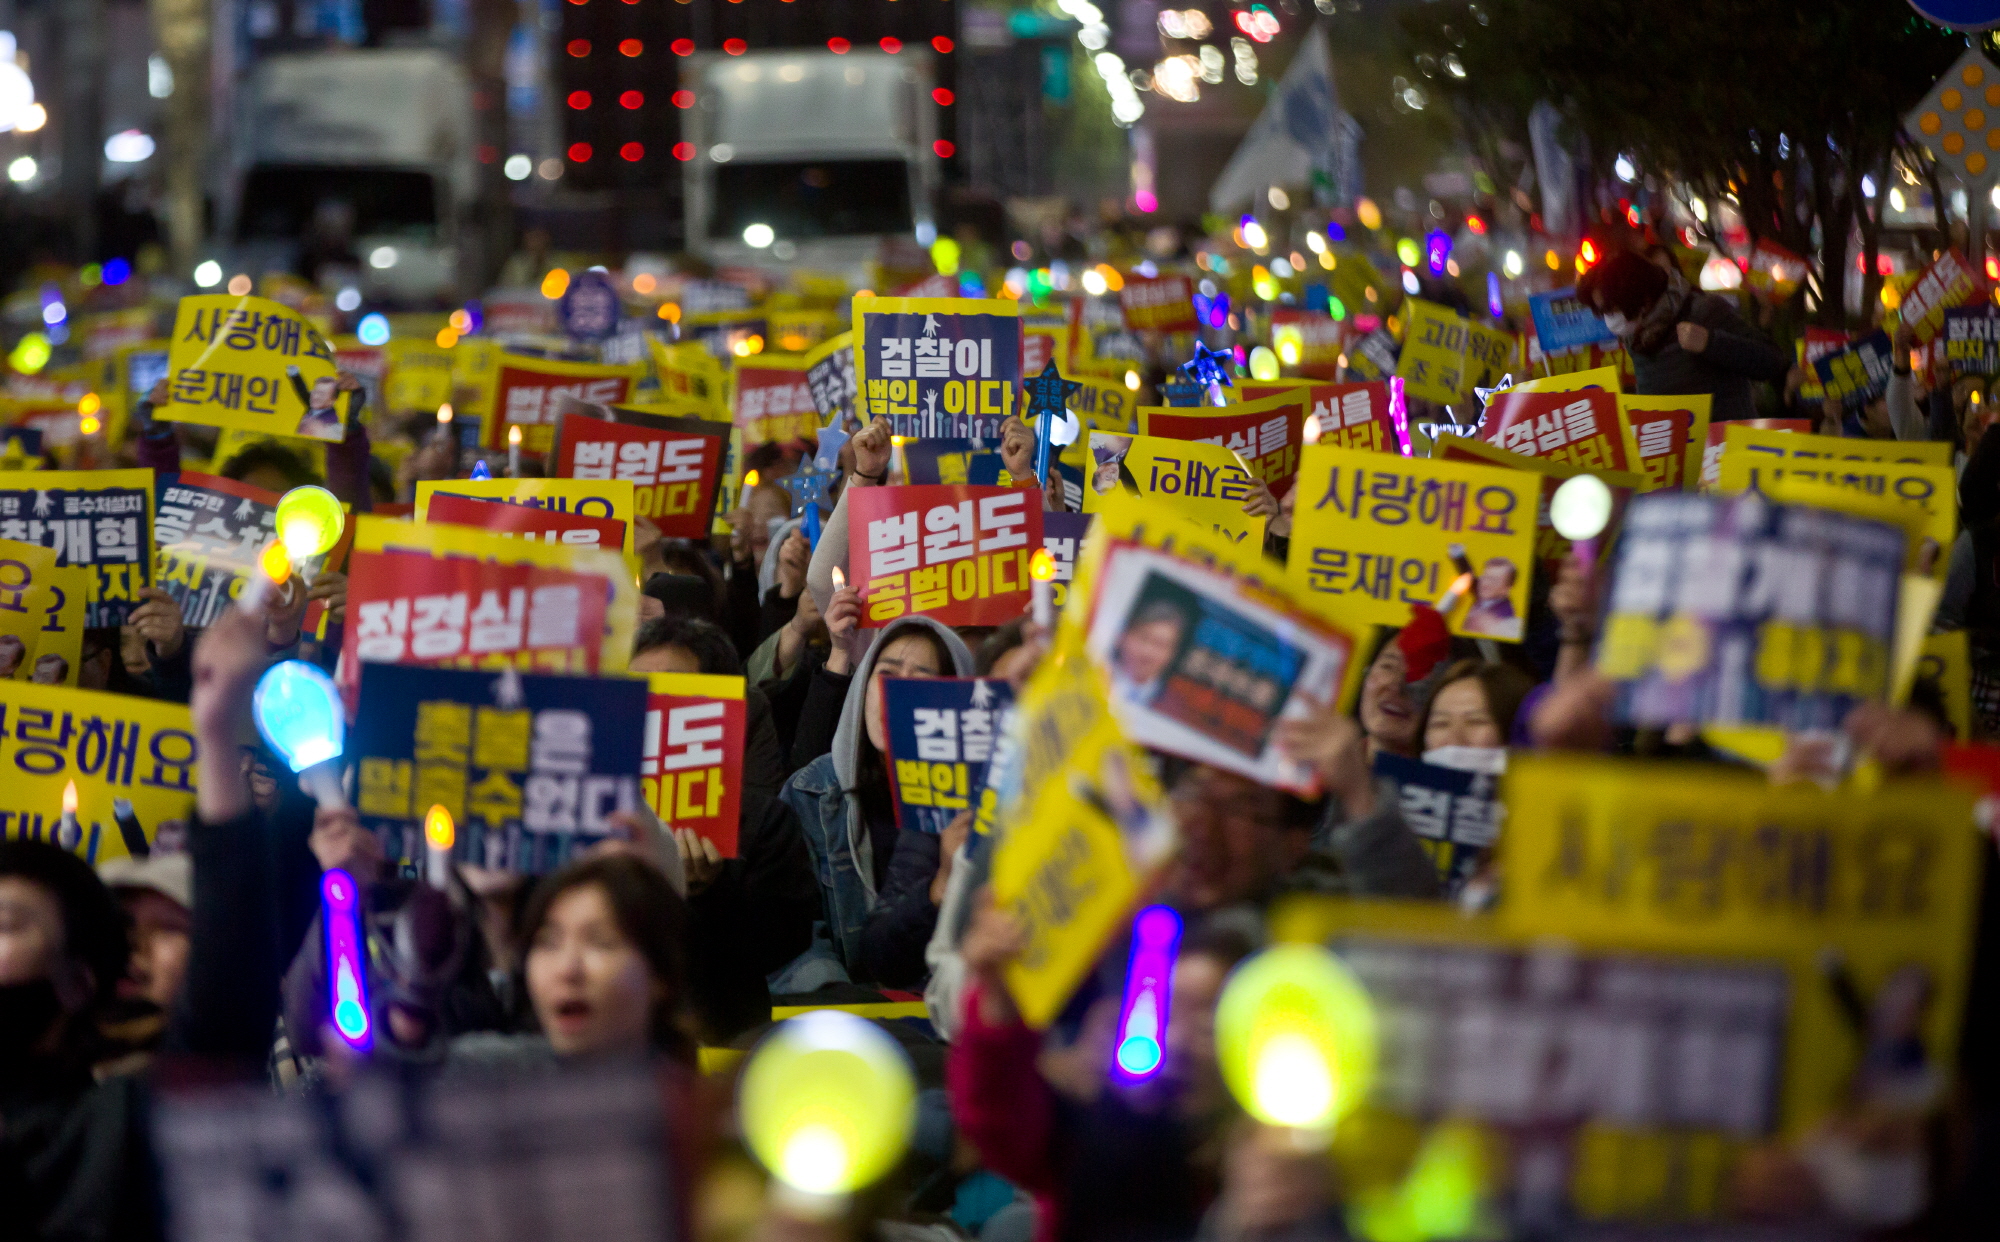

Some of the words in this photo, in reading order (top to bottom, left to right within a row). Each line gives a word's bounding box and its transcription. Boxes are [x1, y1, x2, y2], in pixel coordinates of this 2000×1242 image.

[183, 307, 333, 360] 사랑해요
[881, 336, 992, 378] 검찰이
[1416, 316, 1508, 371] 고마워요
[173, 369, 280, 414] 문재인
[867, 379, 918, 415] 범인
[943, 380, 1015, 416] 이다
[1068, 384, 1124, 420] 해요
[1312, 388, 1372, 433] 심을
[573, 438, 706, 486] 법원도
[1192, 414, 1288, 460] 심을
[162, 487, 226, 513] 검찰규탄
[634, 482, 700, 518] 이다
[1150, 456, 1250, 502] 문재인
[1314, 466, 1517, 535] 사랑해요
[0, 516, 139, 563] 찰개혁
[867, 492, 1028, 577] 법원도
[867, 548, 1031, 621] 공범이다
[1308, 547, 1439, 606] 문재인
[356, 584, 582, 662] 정경심을
[913, 708, 994, 762] 검찰
[523, 772, 638, 836] 없다
[641, 766, 726, 825] 이다
[895, 759, 970, 809] 범인
[1400, 784, 1508, 848] 검찰
